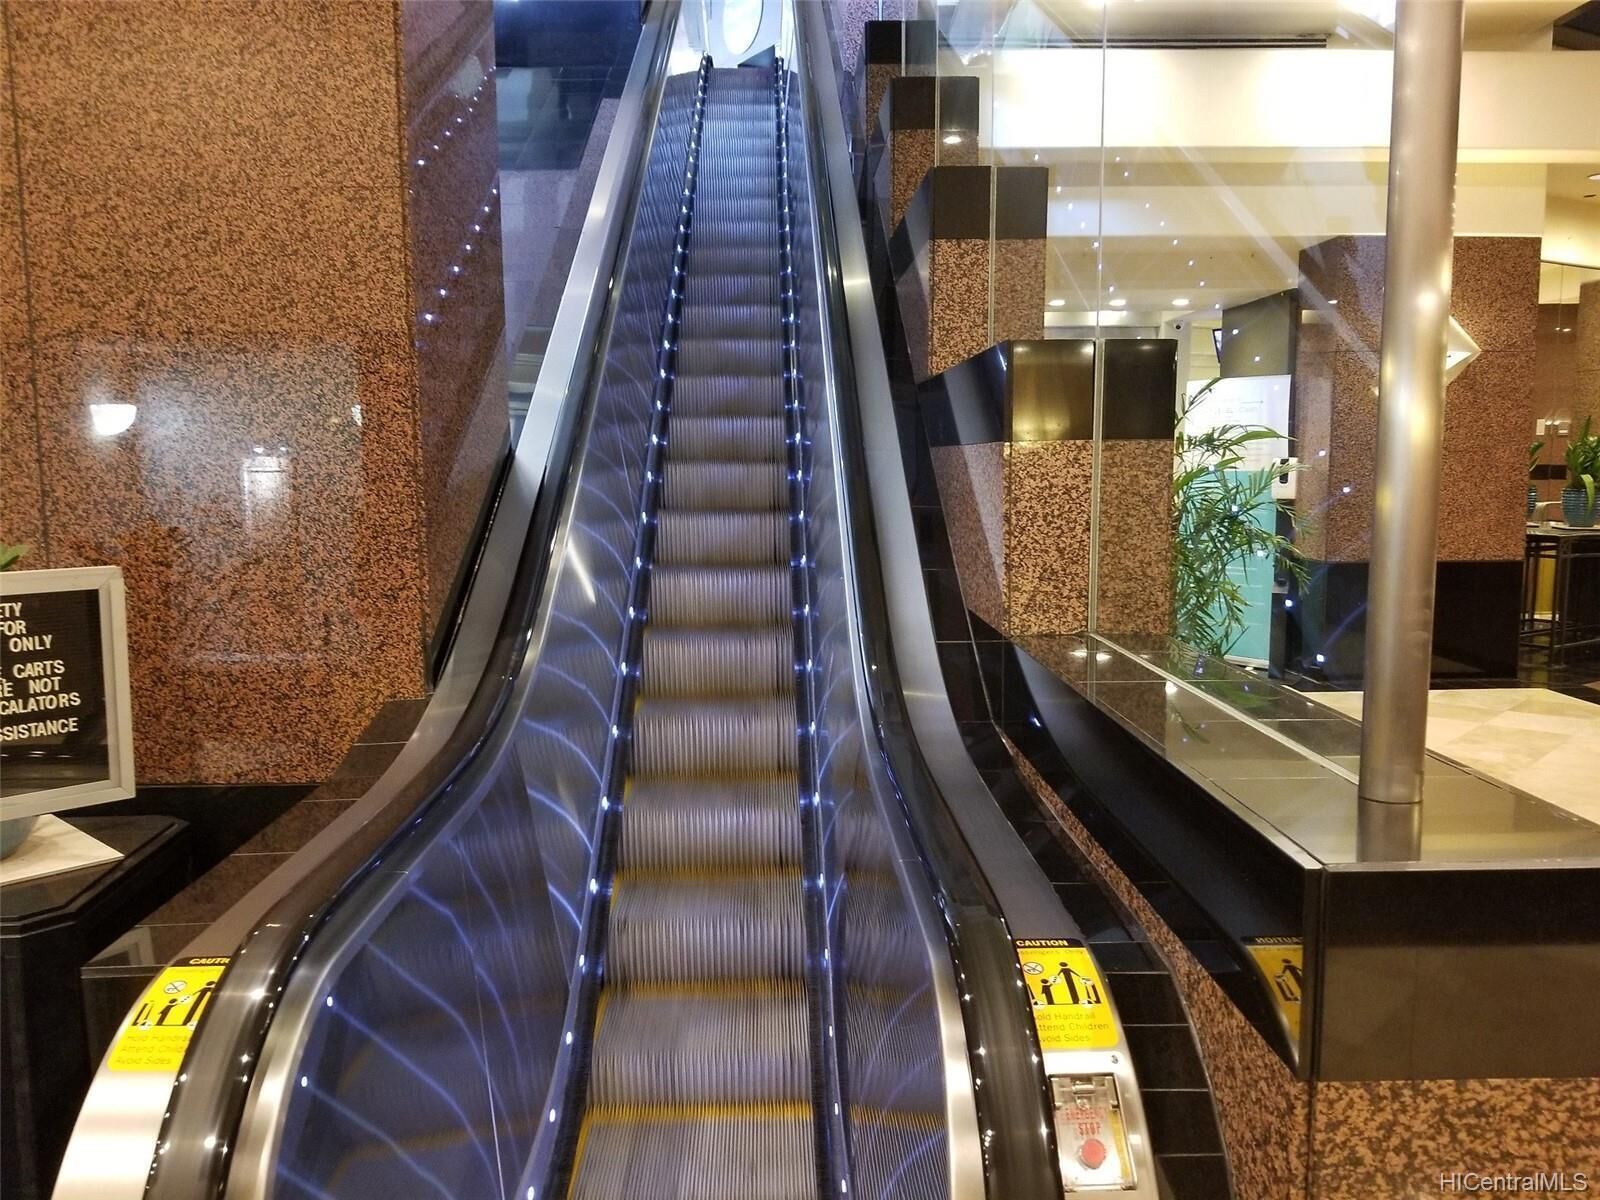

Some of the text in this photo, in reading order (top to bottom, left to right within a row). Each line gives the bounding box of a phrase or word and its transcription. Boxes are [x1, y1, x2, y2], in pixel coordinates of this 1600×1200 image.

[9, 635, 52, 652] ONLY
[12, 660, 65, 678] CARTS
[28, 677, 61, 693] NOT
[0, 717, 79, 741] SISTANCE
[1015, 939, 1069, 947] CAUTION
[1035, 1012, 1052, 1021] old
[1037, 1022, 1110, 1032] ttend Children
[1040, 1034, 1062, 1043] void
